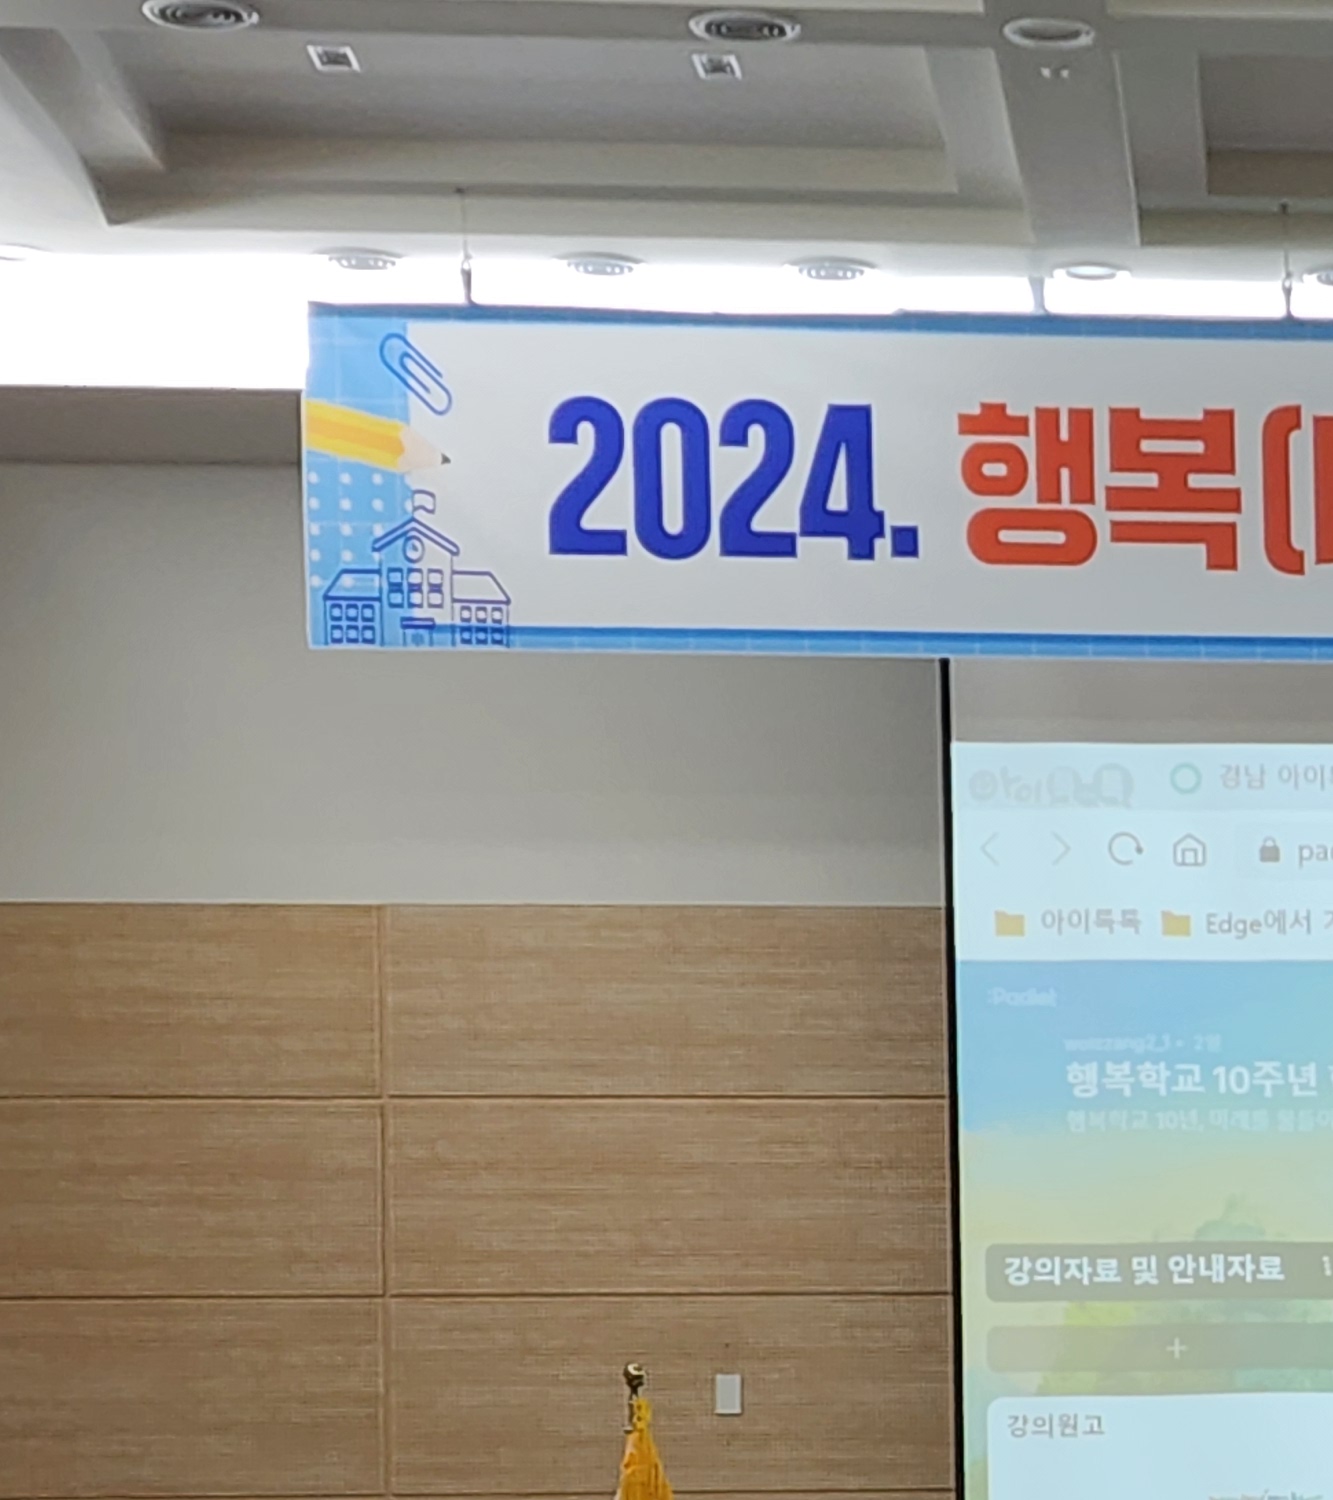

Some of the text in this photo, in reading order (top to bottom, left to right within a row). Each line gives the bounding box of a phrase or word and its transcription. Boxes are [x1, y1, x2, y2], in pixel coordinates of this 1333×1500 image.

[546, 393, 920, 562] 2024.
[1219, 765, 1267, 792] 경남
[1041, 909, 1142, 935] 아이톡톡
[1206, 909, 1312, 937] Edge에서
[1065, 1062, 1204, 1099] 행복학교
[1212, 1062, 1318, 1097] 10주년
[1065, 1108, 1151, 1134] 행복학교
[1004, 1254, 1286, 1286] 강의자료 및 안내자료
[1006, 1414, 1105, 1439] 강의원고
